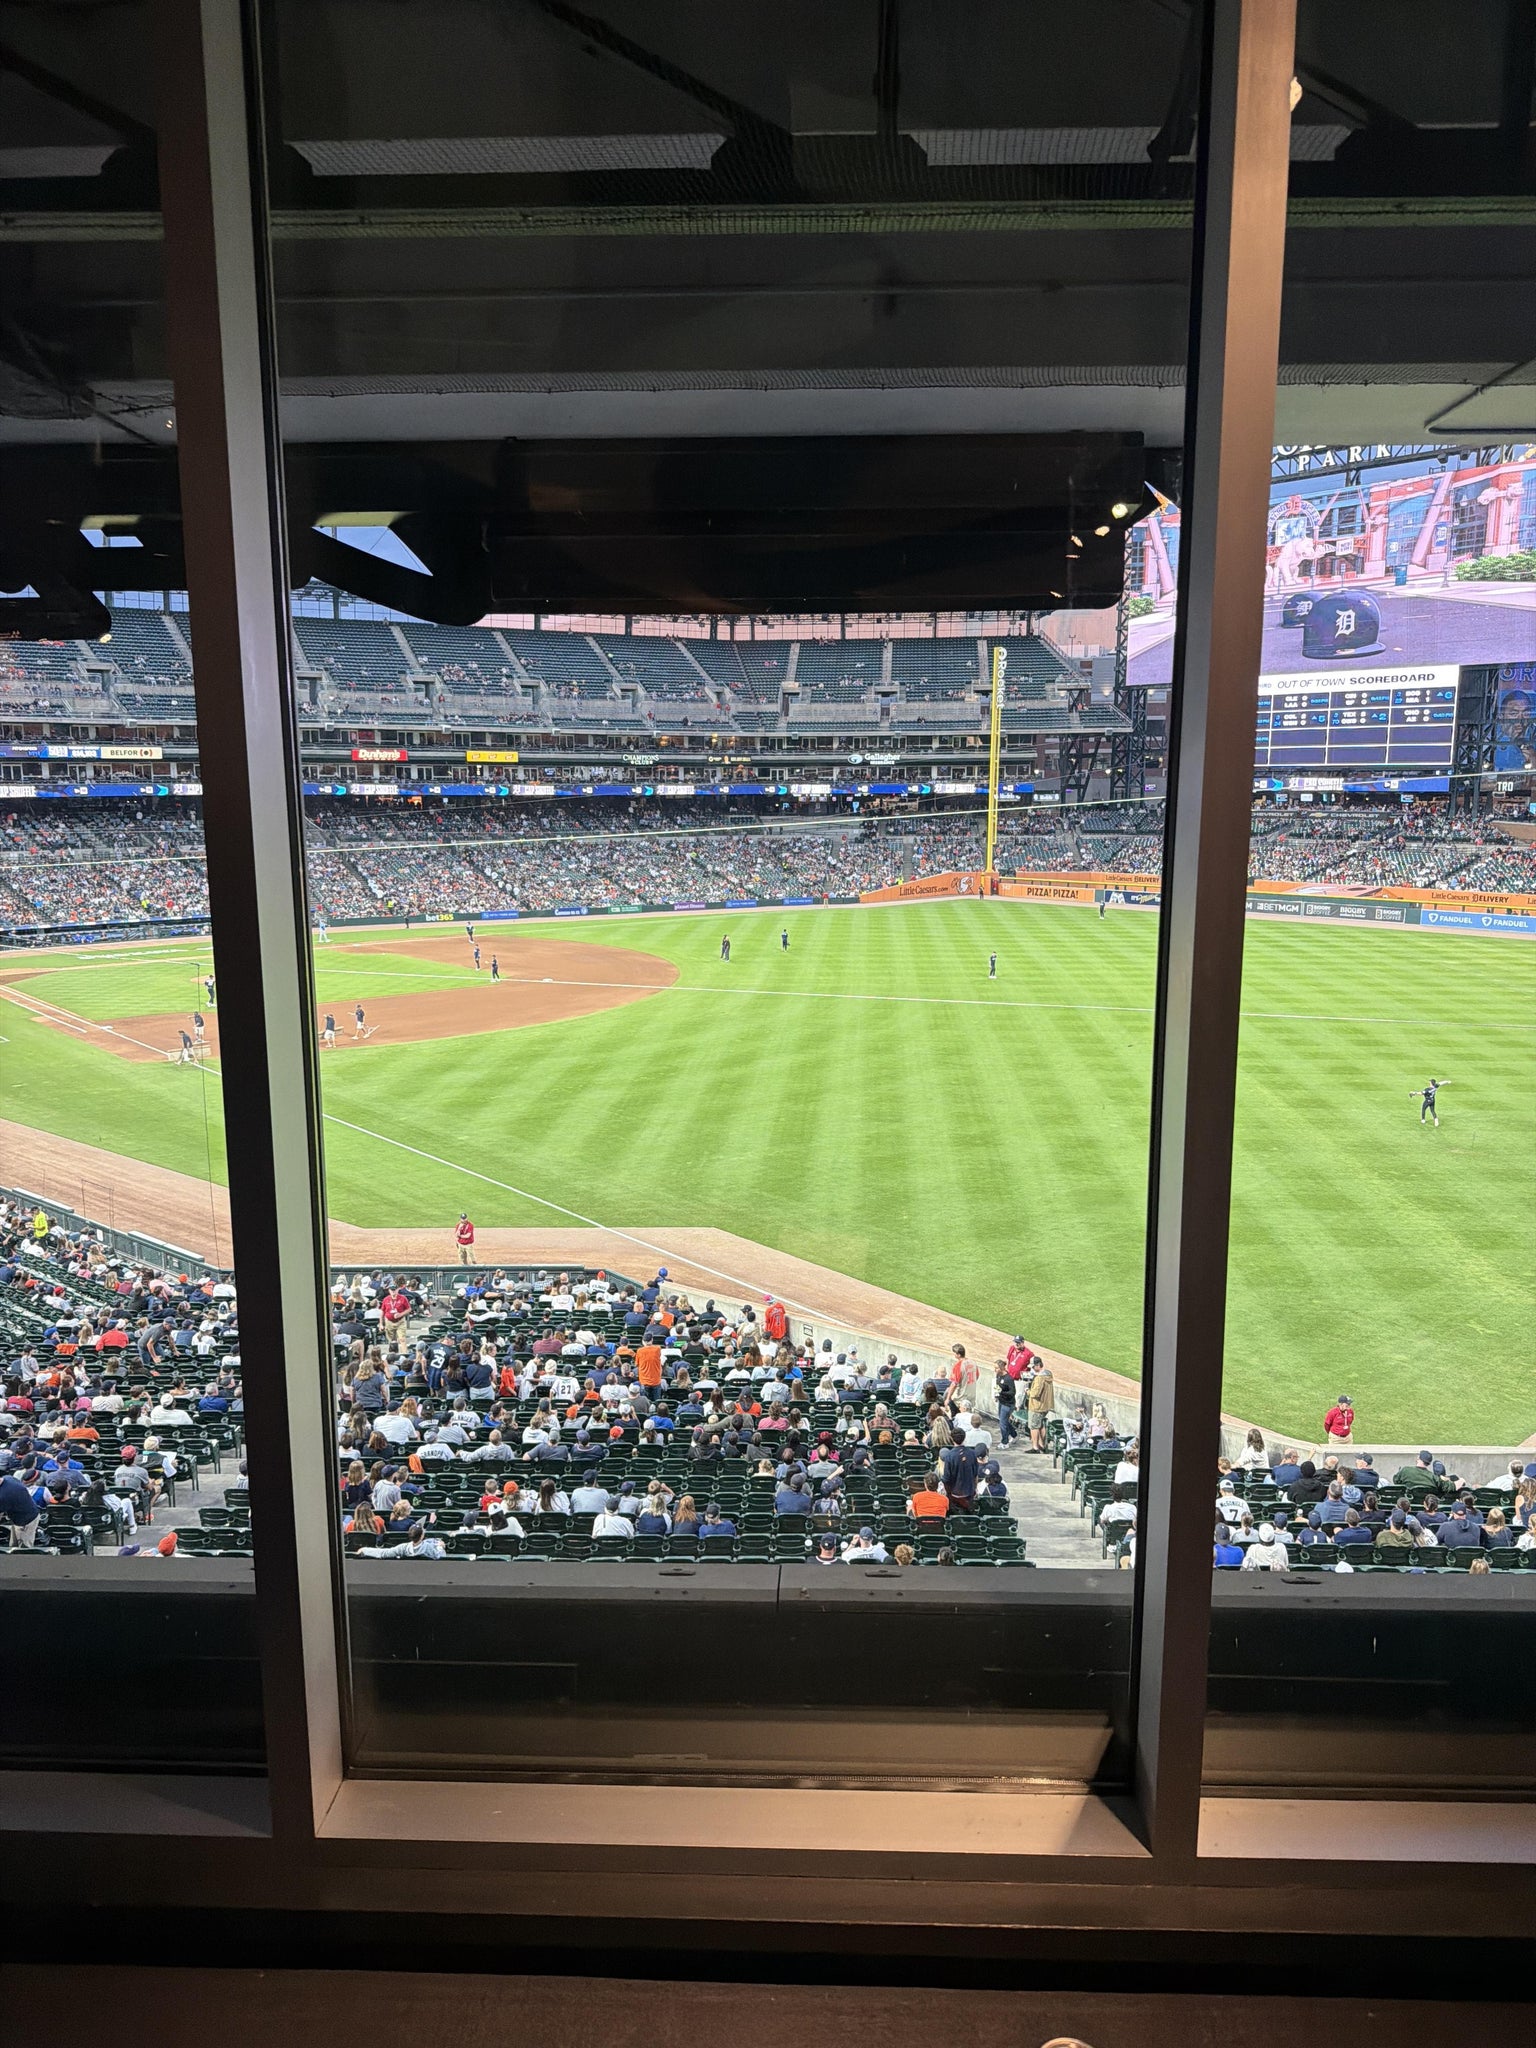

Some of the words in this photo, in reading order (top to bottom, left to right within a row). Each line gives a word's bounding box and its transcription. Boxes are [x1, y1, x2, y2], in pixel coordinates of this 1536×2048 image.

[1298, 444, 1391, 471] PARK
[1334, 609, 1355, 639] D
[1277, 680, 1298, 689] OUT
[1299, 679, 1313, 688] OF
[1315, 677, 1346, 687] TOWN
[1349, 673, 1436, 685] SCOREBOARD
[358, 749, 401, 759] Dunham's
[622, 754, 660, 762] CHAMPIONS
[864, 753, 901, 762] Gallagher
[1134, 875, 1160, 883] DELIVERY
[1026, 887, 1052, 897] PIZZA!
[1053, 889, 1079, 899] PIZZA!
[1472, 893, 1509, 904] DELIVERY
[1263, 902, 1299, 912] BETMGM
[425, 913, 454, 922] bet365
[1439, 915, 1473, 925] FANDUEL
[1493, 919, 1529, 929] FANDUEL
[430, 1355, 445, 1369] 29
[560, 1384, 572, 1395] 27
[1229, 1508, 1239, 1521] 7
